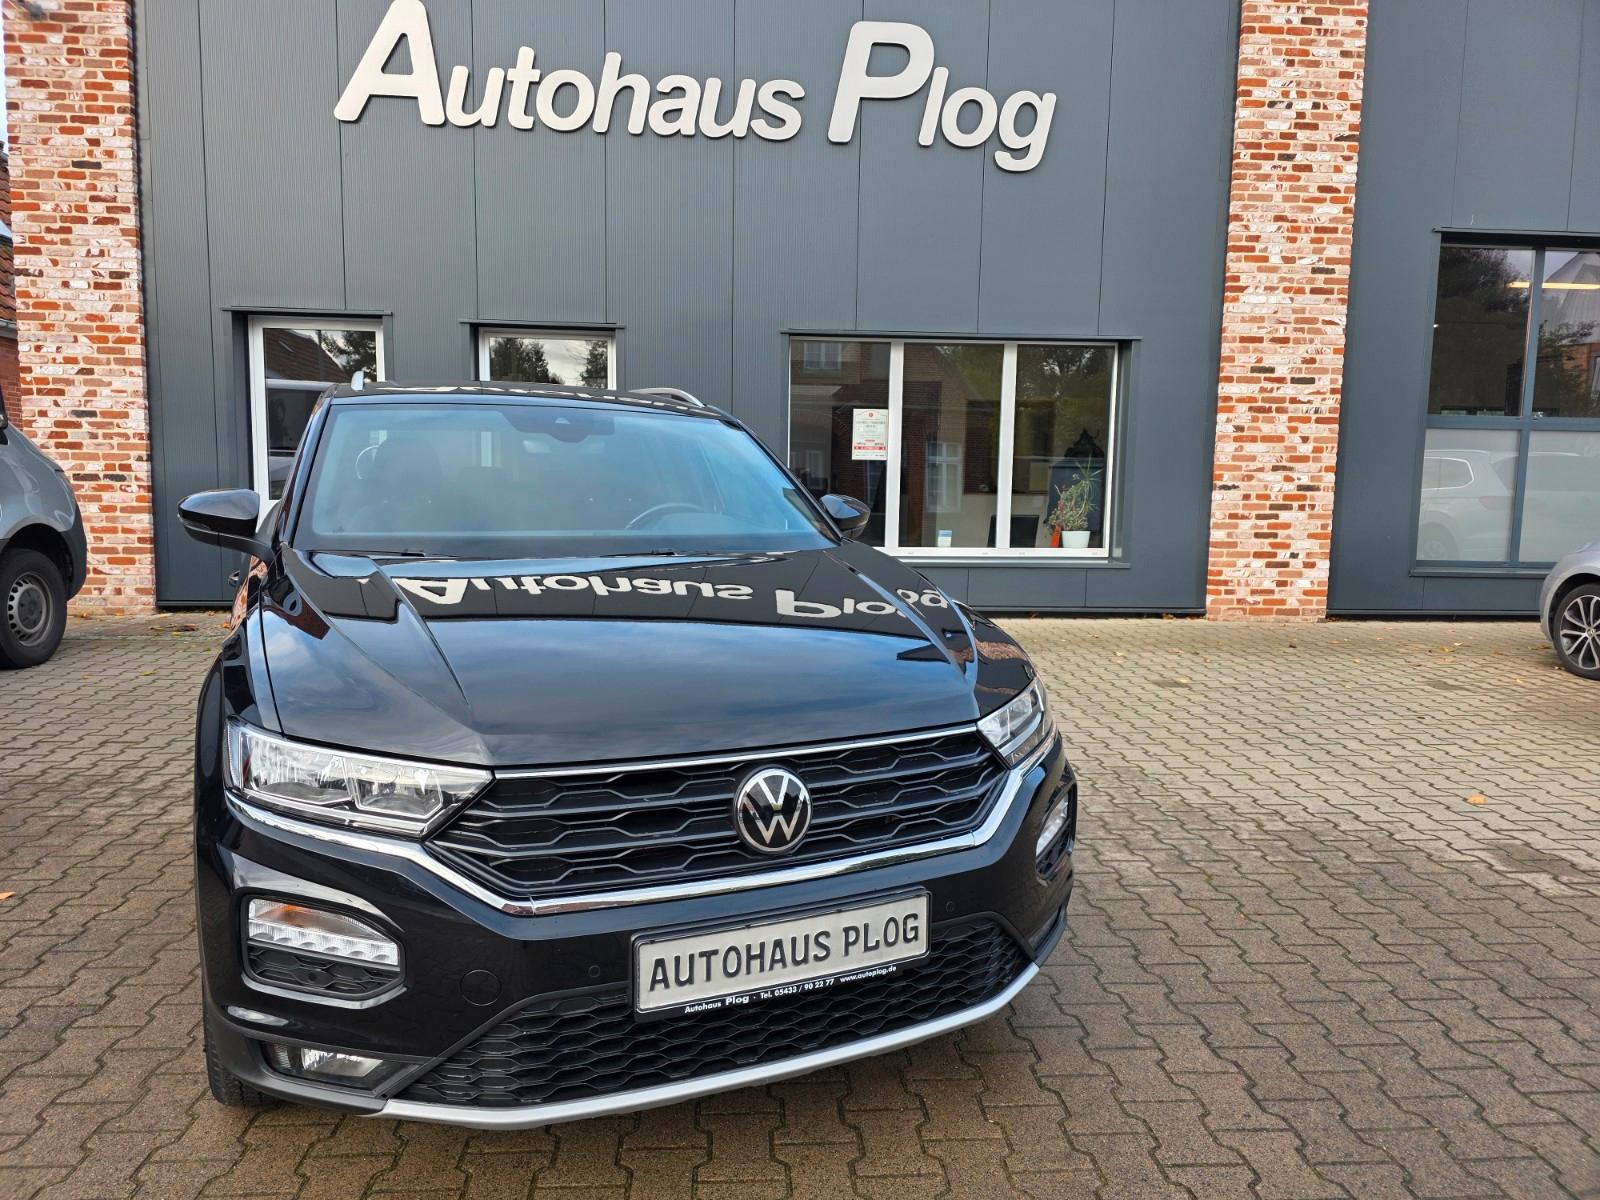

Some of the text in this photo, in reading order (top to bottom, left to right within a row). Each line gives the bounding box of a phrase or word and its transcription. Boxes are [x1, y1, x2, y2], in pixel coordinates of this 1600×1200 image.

[333, 0, 1057, 172] Autohaus Plog
[648, 912, 920, 993] AUTOHAUS PLOG
[684, 1001, 722, 1014] Autohaus
[725, 994, 750, 1006] Plog
[760, 991, 773, 999] Tel.
[774, 986, 797, 997] 05433
[804, 983, 814, 991] 90
[814, 981, 824, 989] 22
[825, 979, 835, 987] 77
[839, 965, 897, 984] www.autoplog.de
